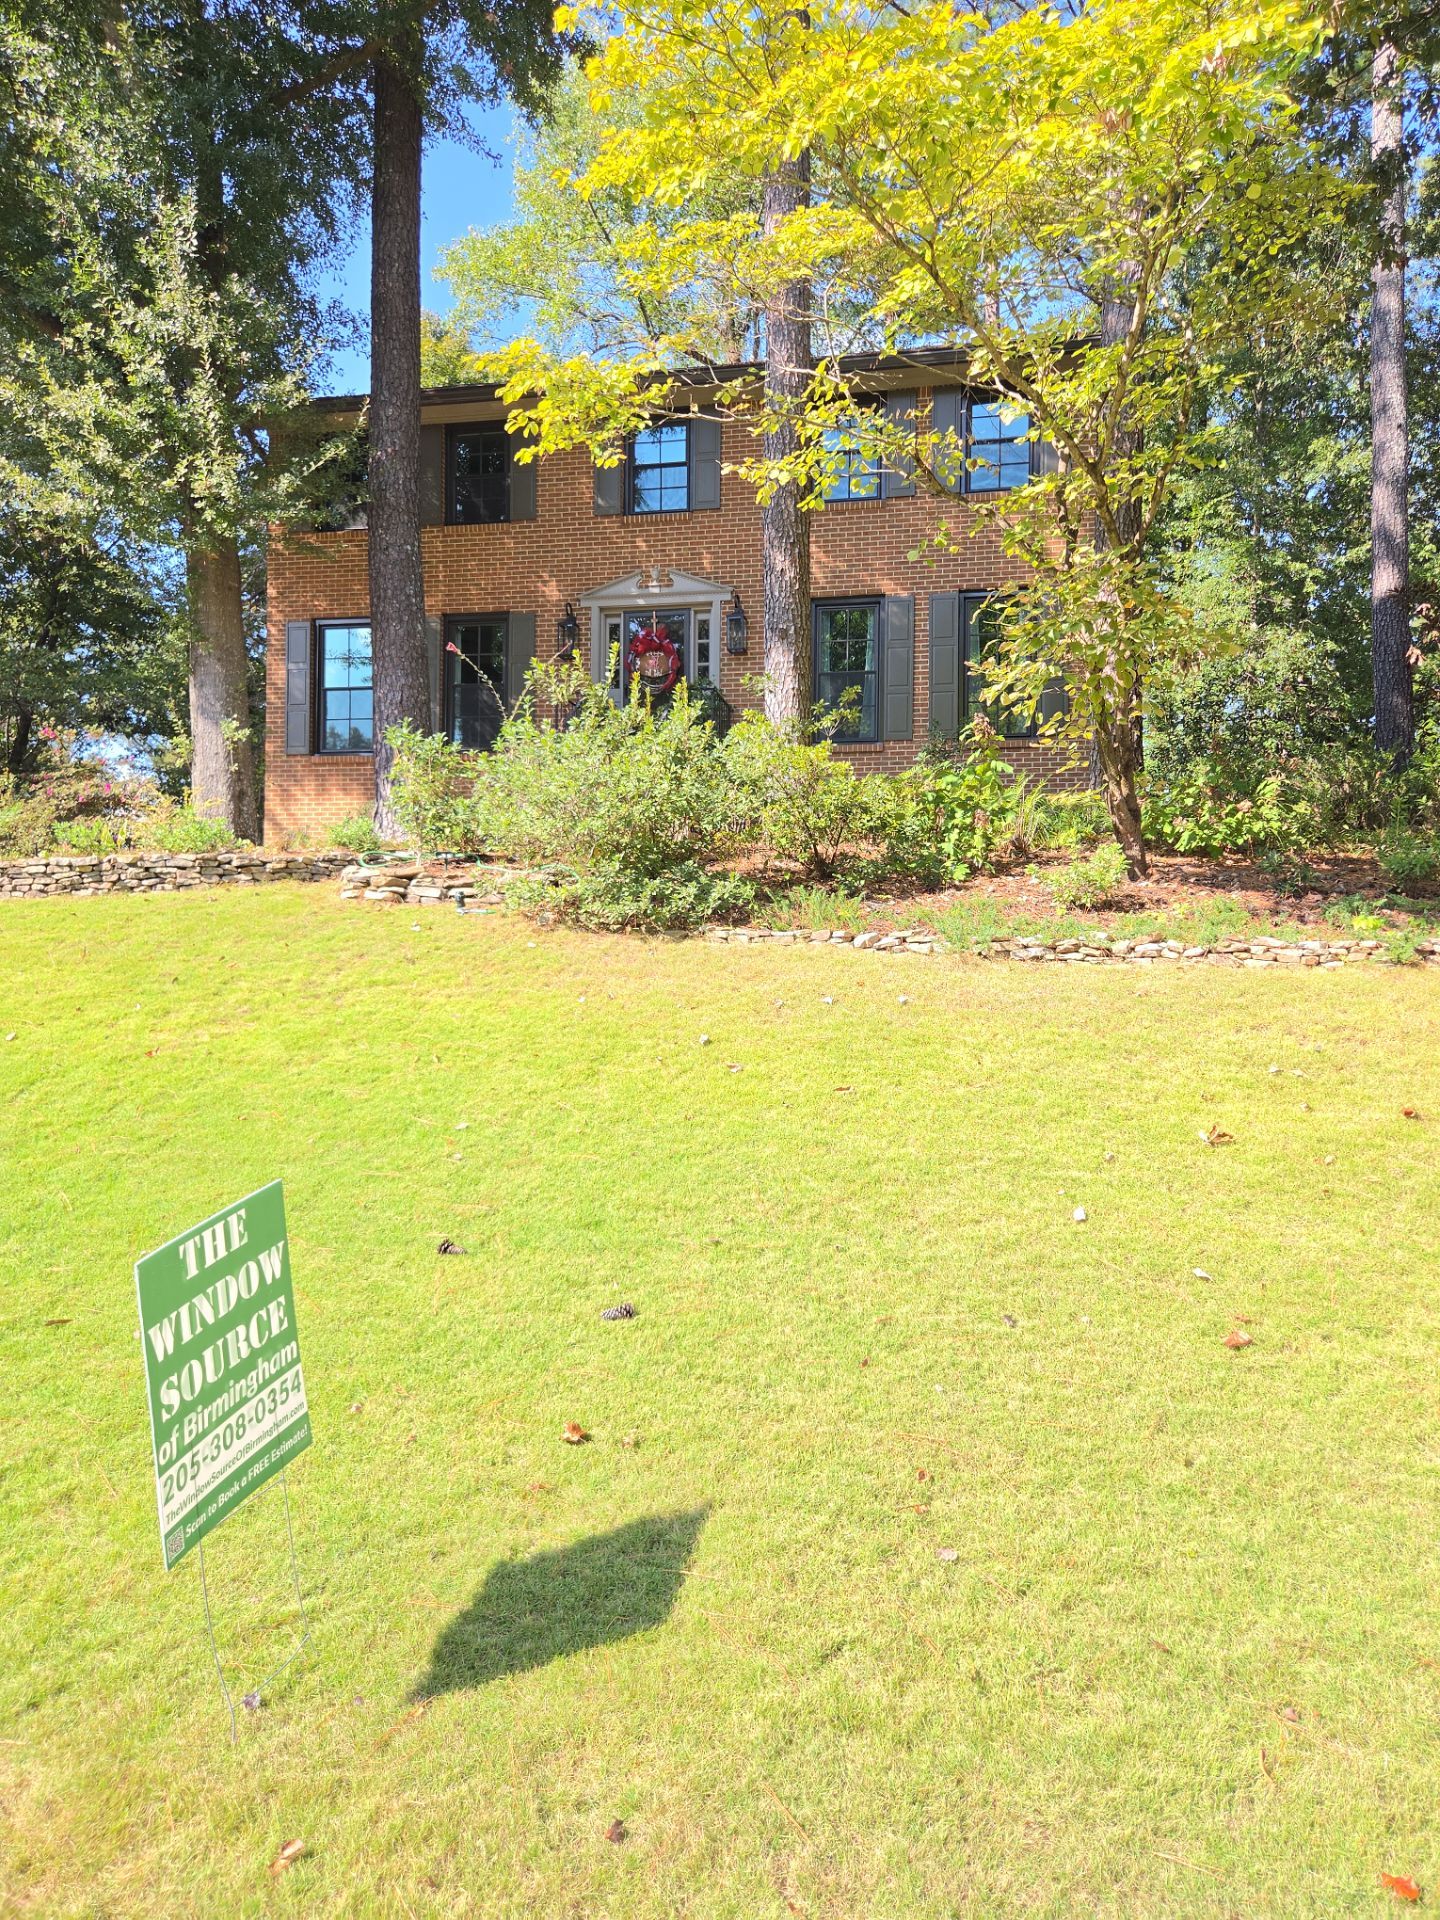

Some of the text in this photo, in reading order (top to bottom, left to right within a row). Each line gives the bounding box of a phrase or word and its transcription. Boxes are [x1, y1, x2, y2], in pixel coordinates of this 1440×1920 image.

[148, 1240, 285, 1363] WINDOW
[179, 1208, 248, 1280] THE
[159, 1341, 298, 1466] of Birmingham
[160, 1295, 288, 1423] SOURCE
[163, 1368, 302, 1506] 205-308-0354
[185, 1513, 206, 1538] Scan
[207, 1503, 217, 1517] to
[218, 1481, 240, 1507] Book
[248, 1455, 270, 1482] FREE
[271, 1424, 308, 1462] Estimate!
